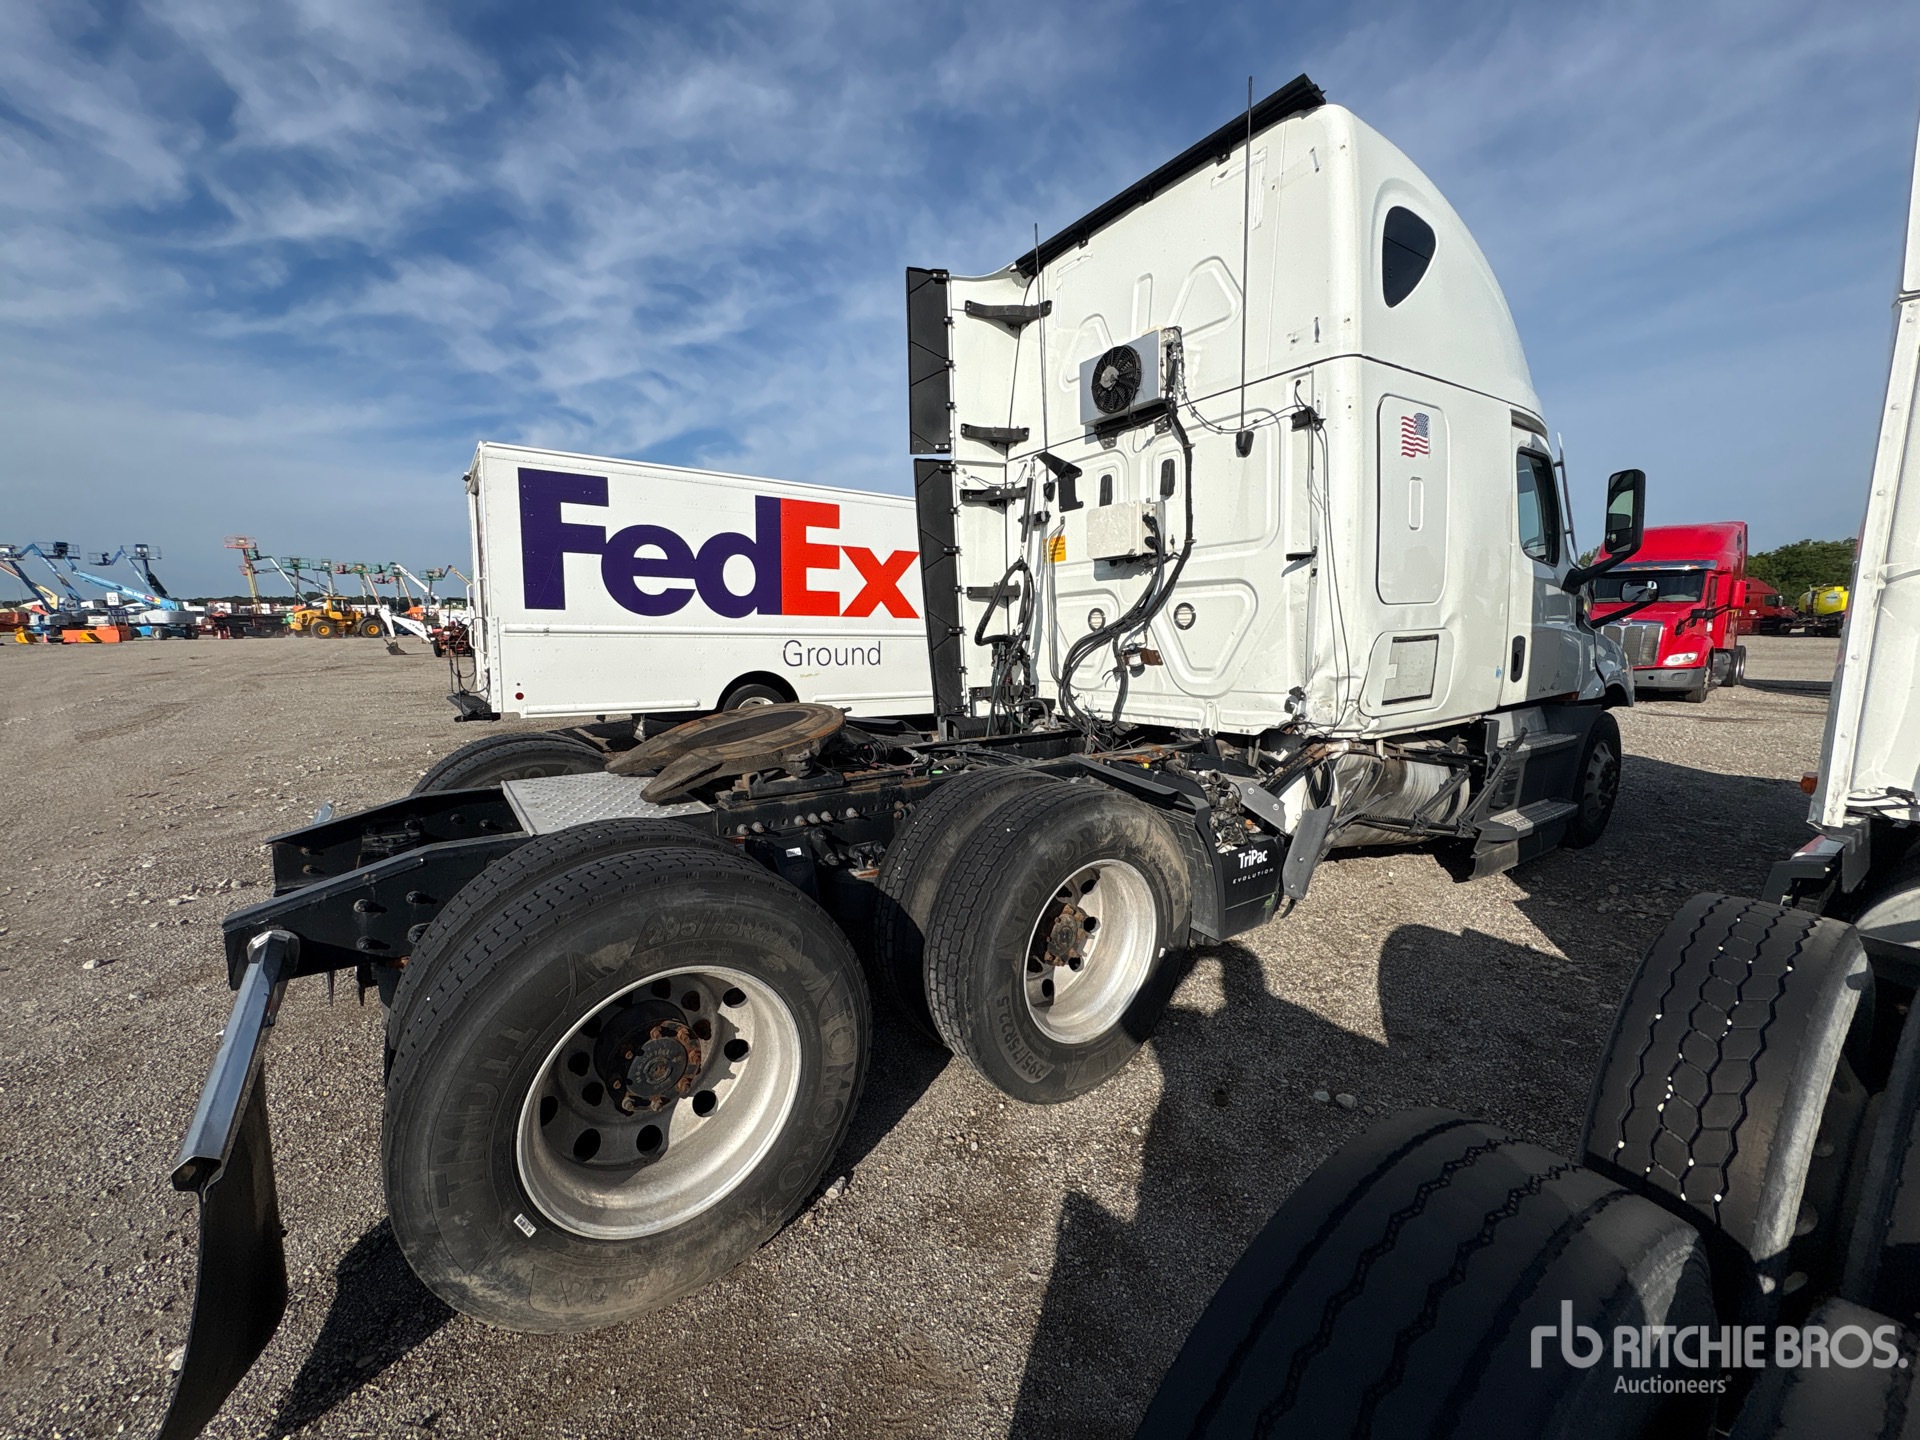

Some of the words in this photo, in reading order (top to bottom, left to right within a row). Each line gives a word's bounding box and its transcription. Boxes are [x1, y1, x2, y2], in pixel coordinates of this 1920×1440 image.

[517, 467, 920, 619] FedEx
[782, 639, 882, 667] Ground
[1237, 849, 1268, 869] TriPac
[1232, 867, 1274, 885] EVOLUTION
[996, 995, 1044, 1079] 295/75R22.5
